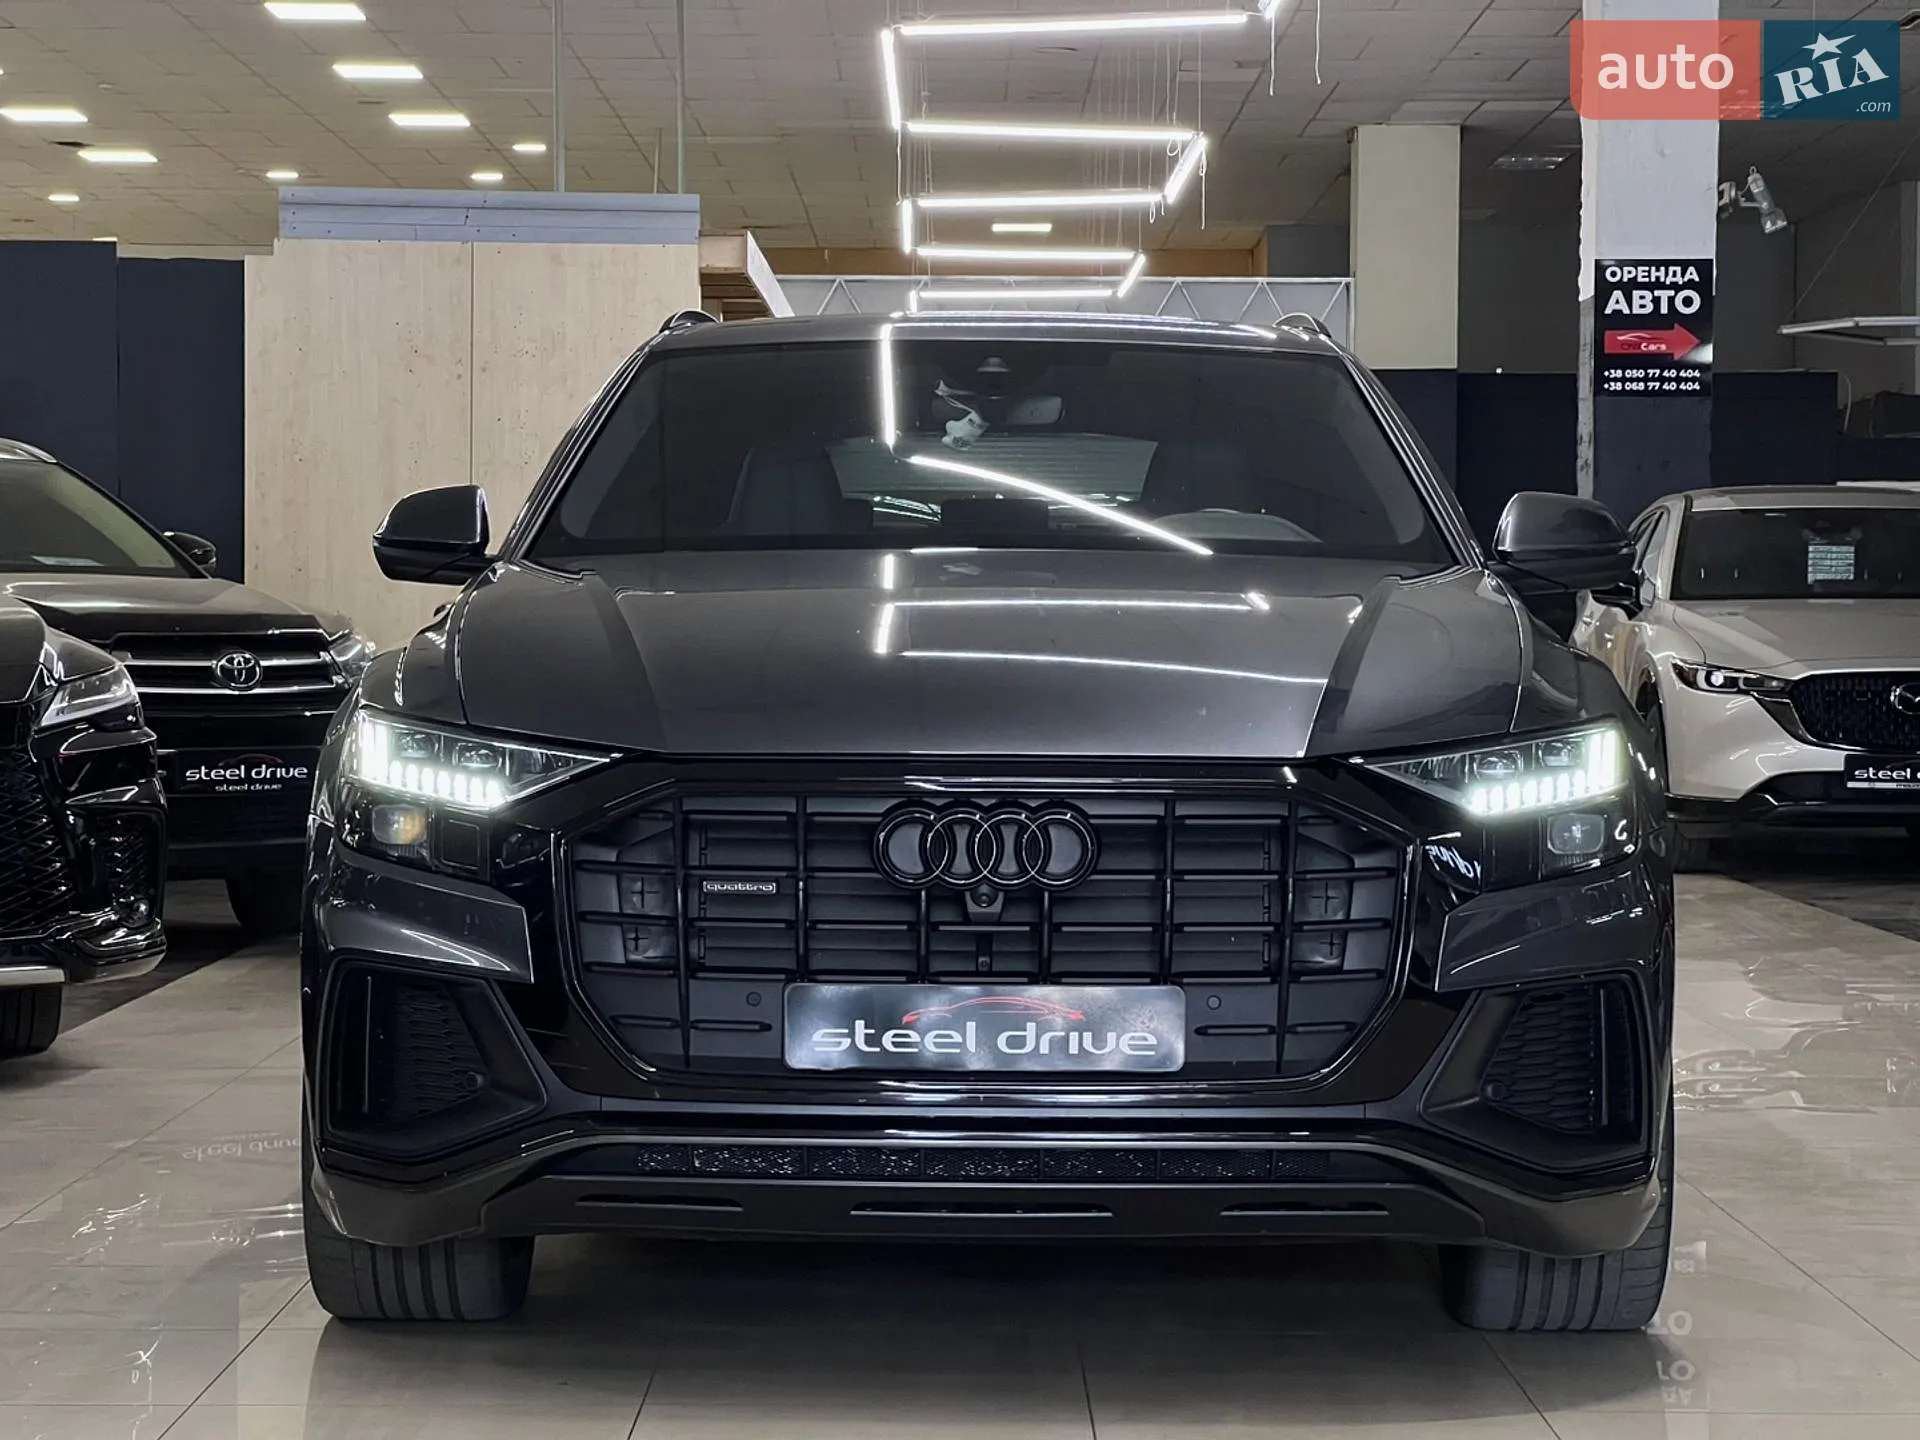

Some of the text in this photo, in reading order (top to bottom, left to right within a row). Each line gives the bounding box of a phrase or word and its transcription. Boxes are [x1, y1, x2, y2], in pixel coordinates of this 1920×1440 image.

[1605, 265, 1700, 285] ОРЕНДА
[1604, 289, 1701, 314] АВТО
[1640, 342, 1667, 351] Cars
[1603, 369, 1623, 378] +38
[1647, 369, 1661, 378] 77
[1662, 369, 1677, 378] 40
[1679, 369, 1701, 378] 404
[1603, 381, 1623, 391] +38
[1647, 381, 1661, 391] 77
[1662, 381, 1677, 391] 40
[1679, 381, 1701, 391] 404
[185, 764, 308, 781] steel drive
[1854, 766, 1911, 780] steel
[705, 882, 774, 892] quattro
[811, 1020, 1158, 1056] steel drive
